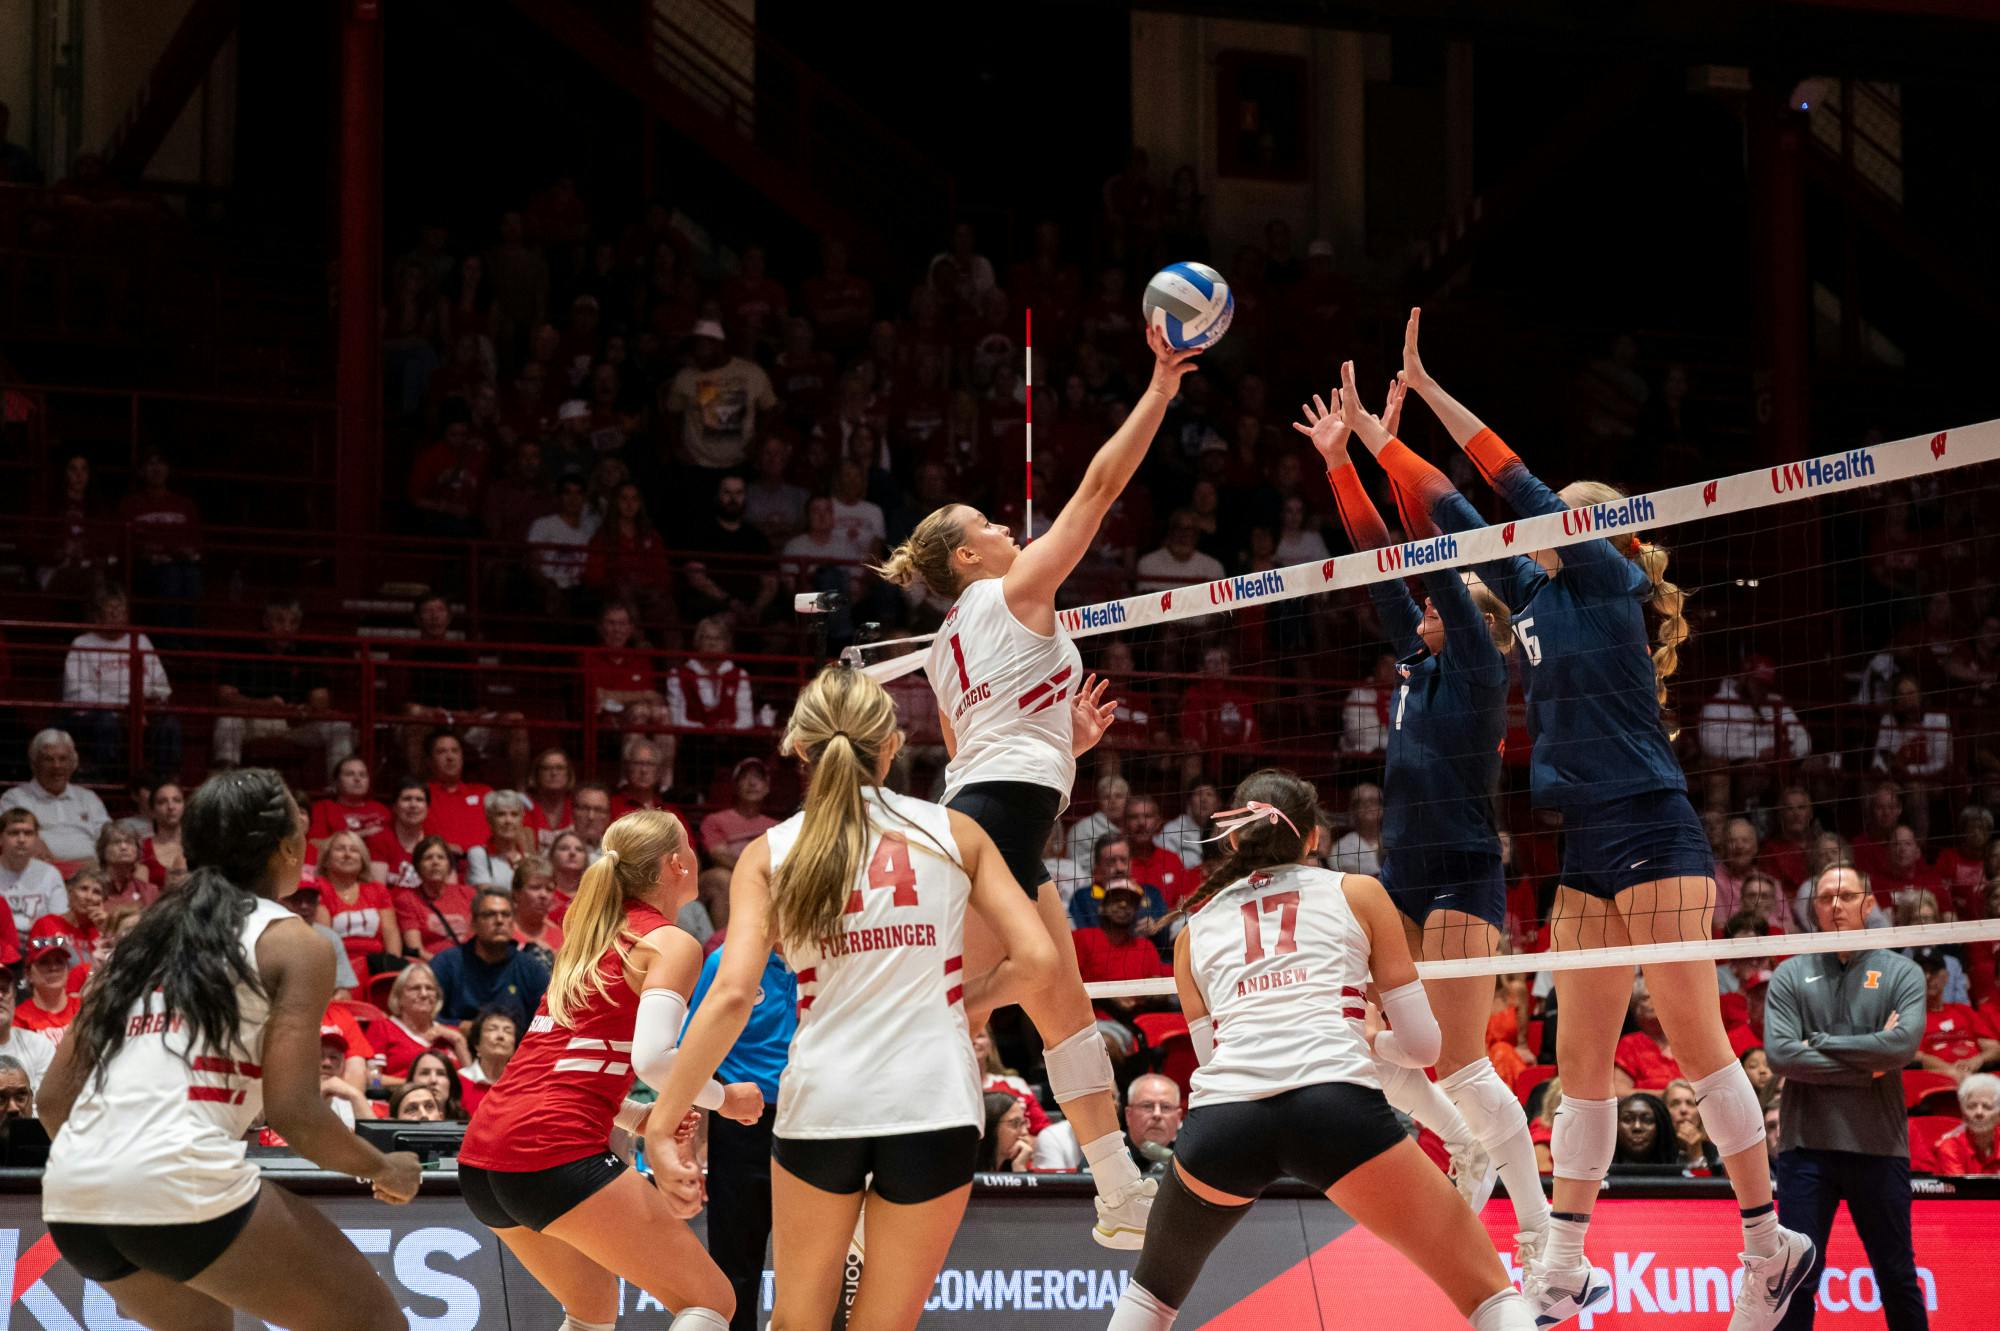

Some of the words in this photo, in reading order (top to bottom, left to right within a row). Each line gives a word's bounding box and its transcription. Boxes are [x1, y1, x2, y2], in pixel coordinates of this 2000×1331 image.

[950, 632, 970, 694] 1
[1240, 890, 1301, 965] 17
[1237, 967, 1308, 997] ANDREW
